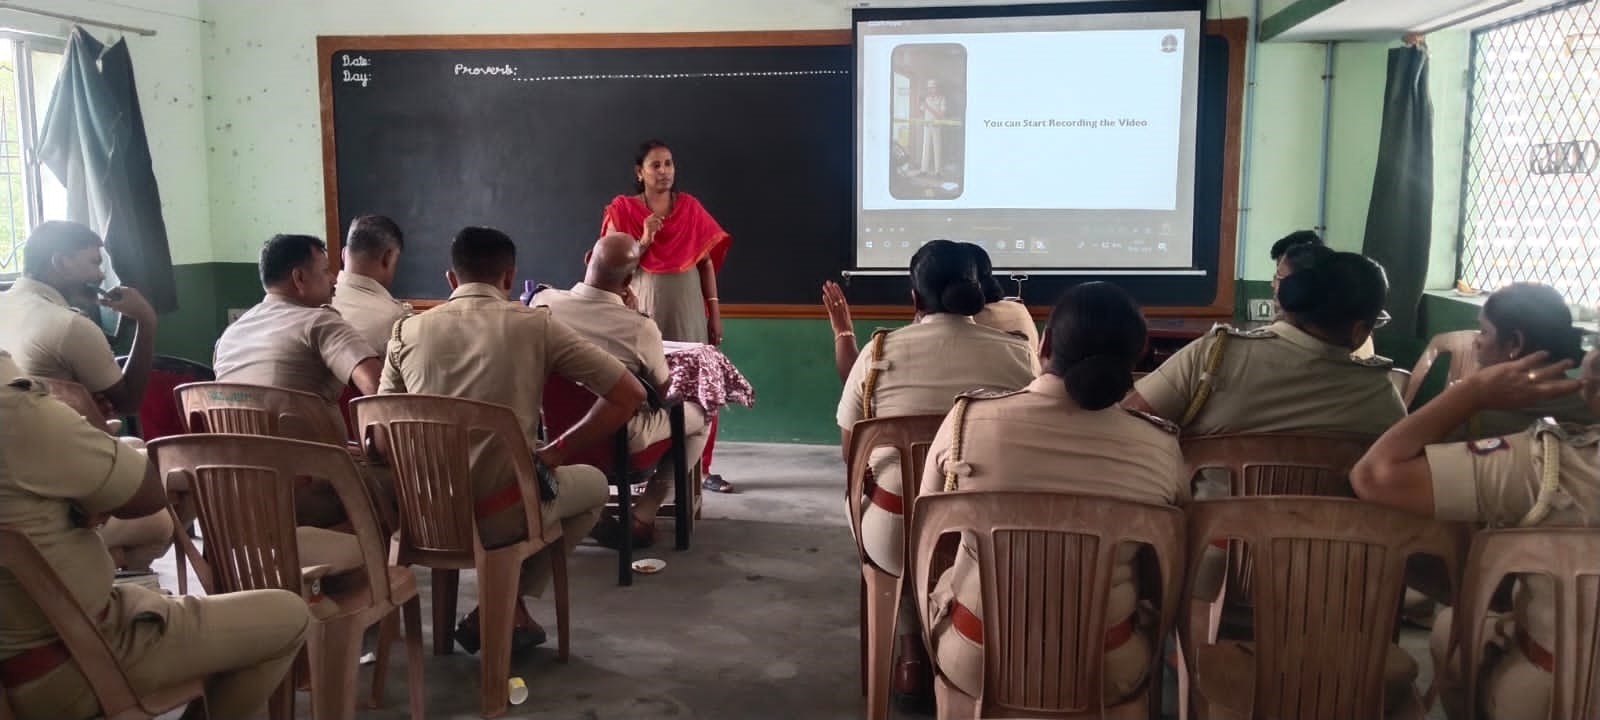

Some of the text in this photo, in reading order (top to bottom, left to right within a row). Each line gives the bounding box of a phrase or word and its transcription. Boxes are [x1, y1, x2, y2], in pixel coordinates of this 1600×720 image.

[343, 69, 371, 87] Day:
[983, 118, 1148, 129] You can Start Recording the Video
